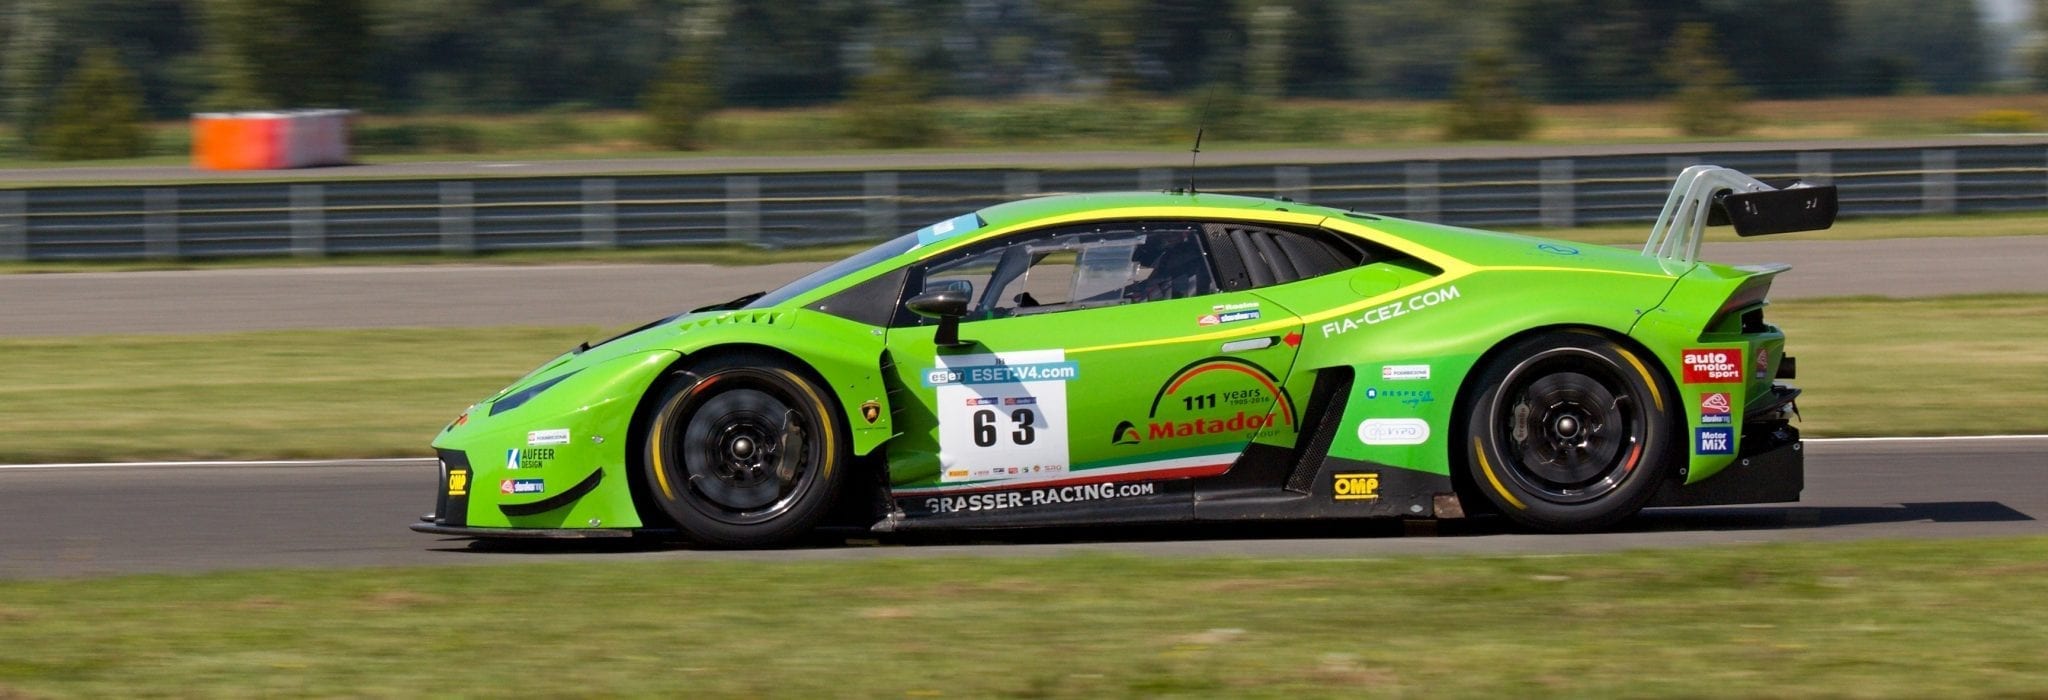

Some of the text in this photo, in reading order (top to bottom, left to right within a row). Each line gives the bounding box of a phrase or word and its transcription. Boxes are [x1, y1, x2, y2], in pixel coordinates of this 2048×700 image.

[1322, 285, 1460, 338] FIA-CEZ.COM
[1684, 353, 1727, 364] auto
[972, 366, 1074, 381] ESET-V4.com
[1693, 363, 1735, 371] motor
[1709, 370, 1739, 378] sport
[1182, 388, 1261, 411] 111 years
[1148, 411, 1277, 440] Matador
[1702, 431, 1727, 439] Motor
[1702, 438, 1727, 451] MiX
[522, 448, 554, 460] AUFEER
[522, 461, 543, 469] DESIGN
[449, 475, 467, 490] OMP
[1334, 478, 1379, 495] OMP
[925, 482, 1154, 513] GRASSER-RACING.COM
